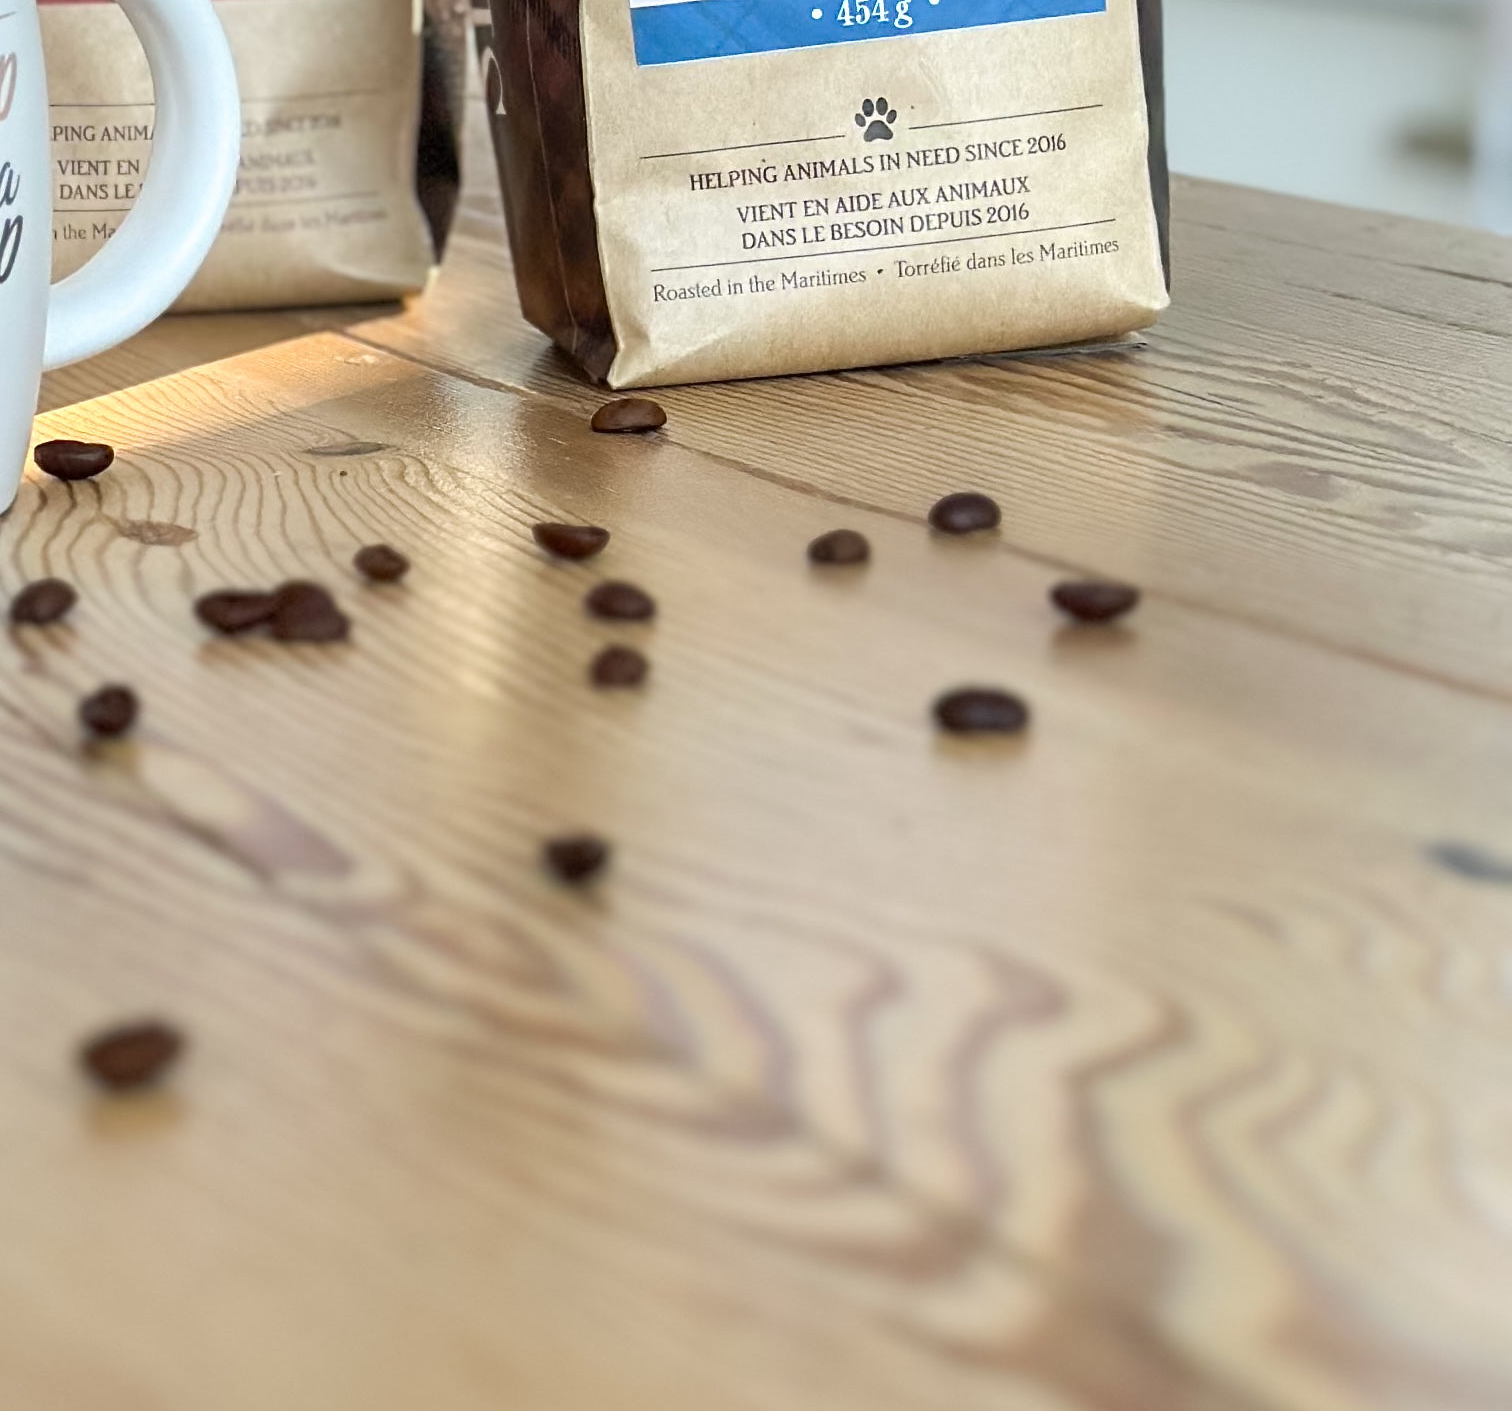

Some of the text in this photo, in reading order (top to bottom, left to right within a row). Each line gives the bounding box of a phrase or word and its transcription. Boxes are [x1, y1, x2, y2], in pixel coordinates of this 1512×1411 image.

[51, 124, 154, 141] PING ANIM
[57, 159, 140, 176] VIENT EN
[690, 133, 1067, 191] HELPING ANIMALS IN NEED SINCE 2016
[59, 183, 136, 200] DANS LE
[736, 176, 1031, 224] VIENT EN AIDE AUX ANIMAUX
[63, 223, 87, 240] the
[741, 203, 1030, 250] DANS LE BESOIN DEPUIS 2016
[653, 240, 1120, 302] Roasted in the Maritimes Torréfié dans les Maritimes
